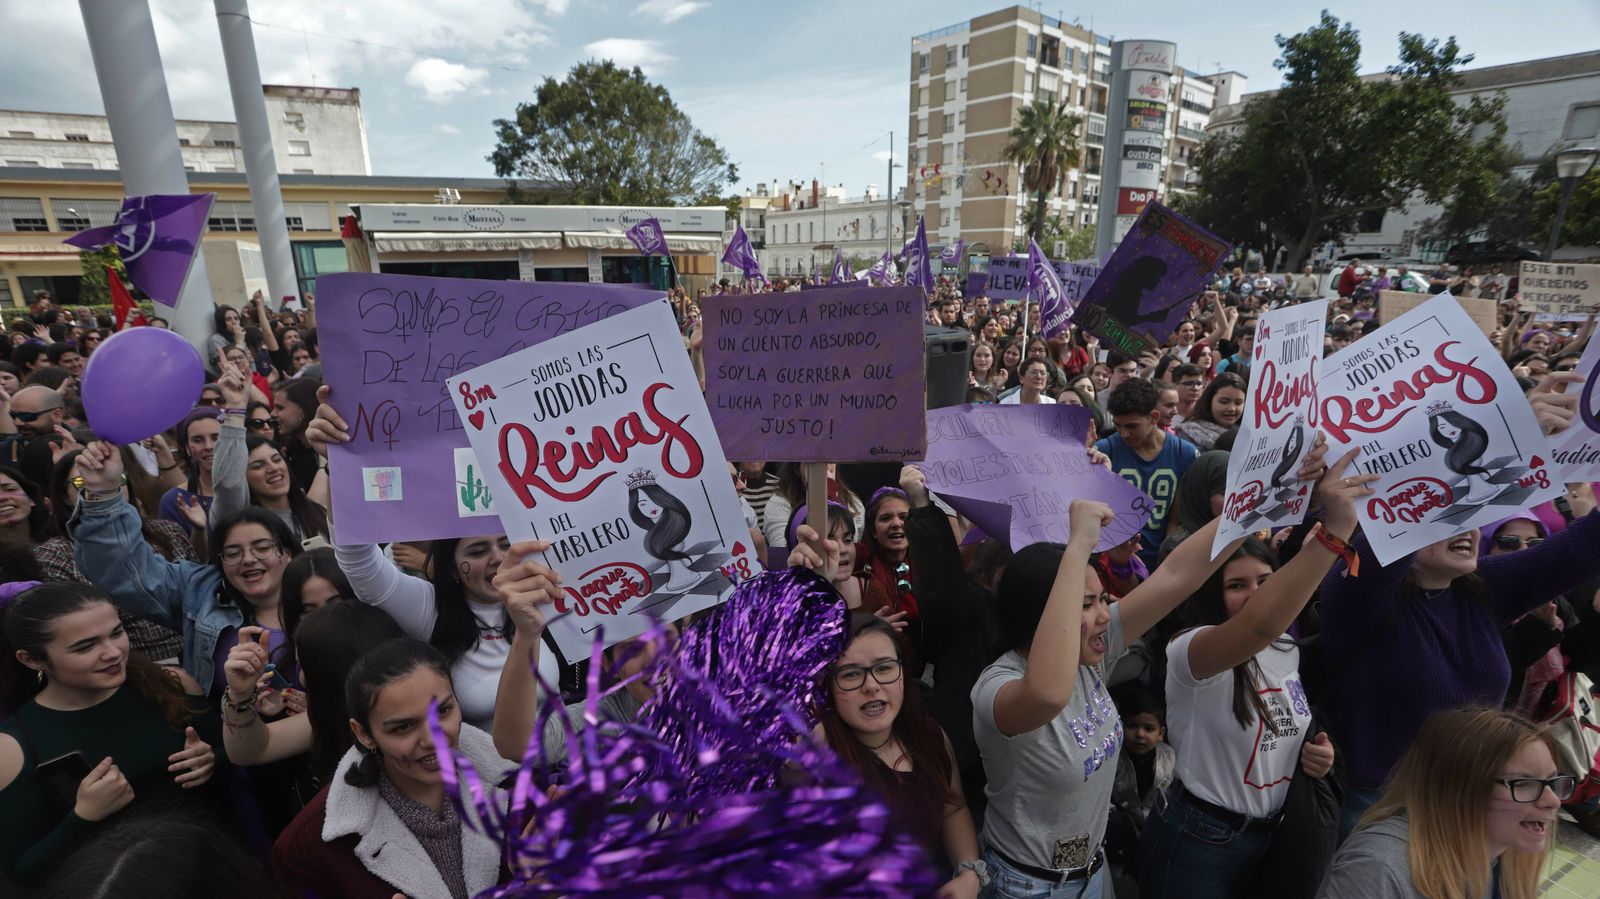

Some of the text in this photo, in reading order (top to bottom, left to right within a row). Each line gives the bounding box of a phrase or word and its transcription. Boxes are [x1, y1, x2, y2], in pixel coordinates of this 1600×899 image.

[1523, 263, 1551, 274] ESTE
[1524, 277, 1588, 290] QUEREMOS
[720, 300, 912, 327] NO SOY LA PRINCESA DE
[1523, 292, 1581, 304] DERECHOS
[358, 287, 460, 344] SOMOS
[1257, 319, 1271, 343] 8m
[718, 331, 881, 353] UN CUENTO ABSURDO,
[1279, 334, 1310, 366] JODIDAS
[1342, 333, 1399, 370] SOMOS LAS
[363, 350, 416, 385] DE
[531, 345, 604, 386] SOMOS LAS
[776, 366, 851, 384] GUERRERA
[863, 363, 894, 381] QUE
[1346, 339, 1420, 391] JODIDAS
[458, 381, 497, 410] 8m
[533, 362, 628, 423] JODIDAS
[717, 393, 897, 411] LUCHA POR UN MUNDO
[1255, 355, 1318, 429] Reinas
[1320, 341, 1497, 445] Reinas
[351, 399, 400, 452] NO
[1034, 411, 1080, 438] LAS
[498, 382, 704, 509] Reinas
[1362, 439, 1385, 456] DEL
[1363, 439, 1432, 475] TABLERO
[549, 512, 576, 535] DEL
[550, 517, 630, 564] TABLERO
